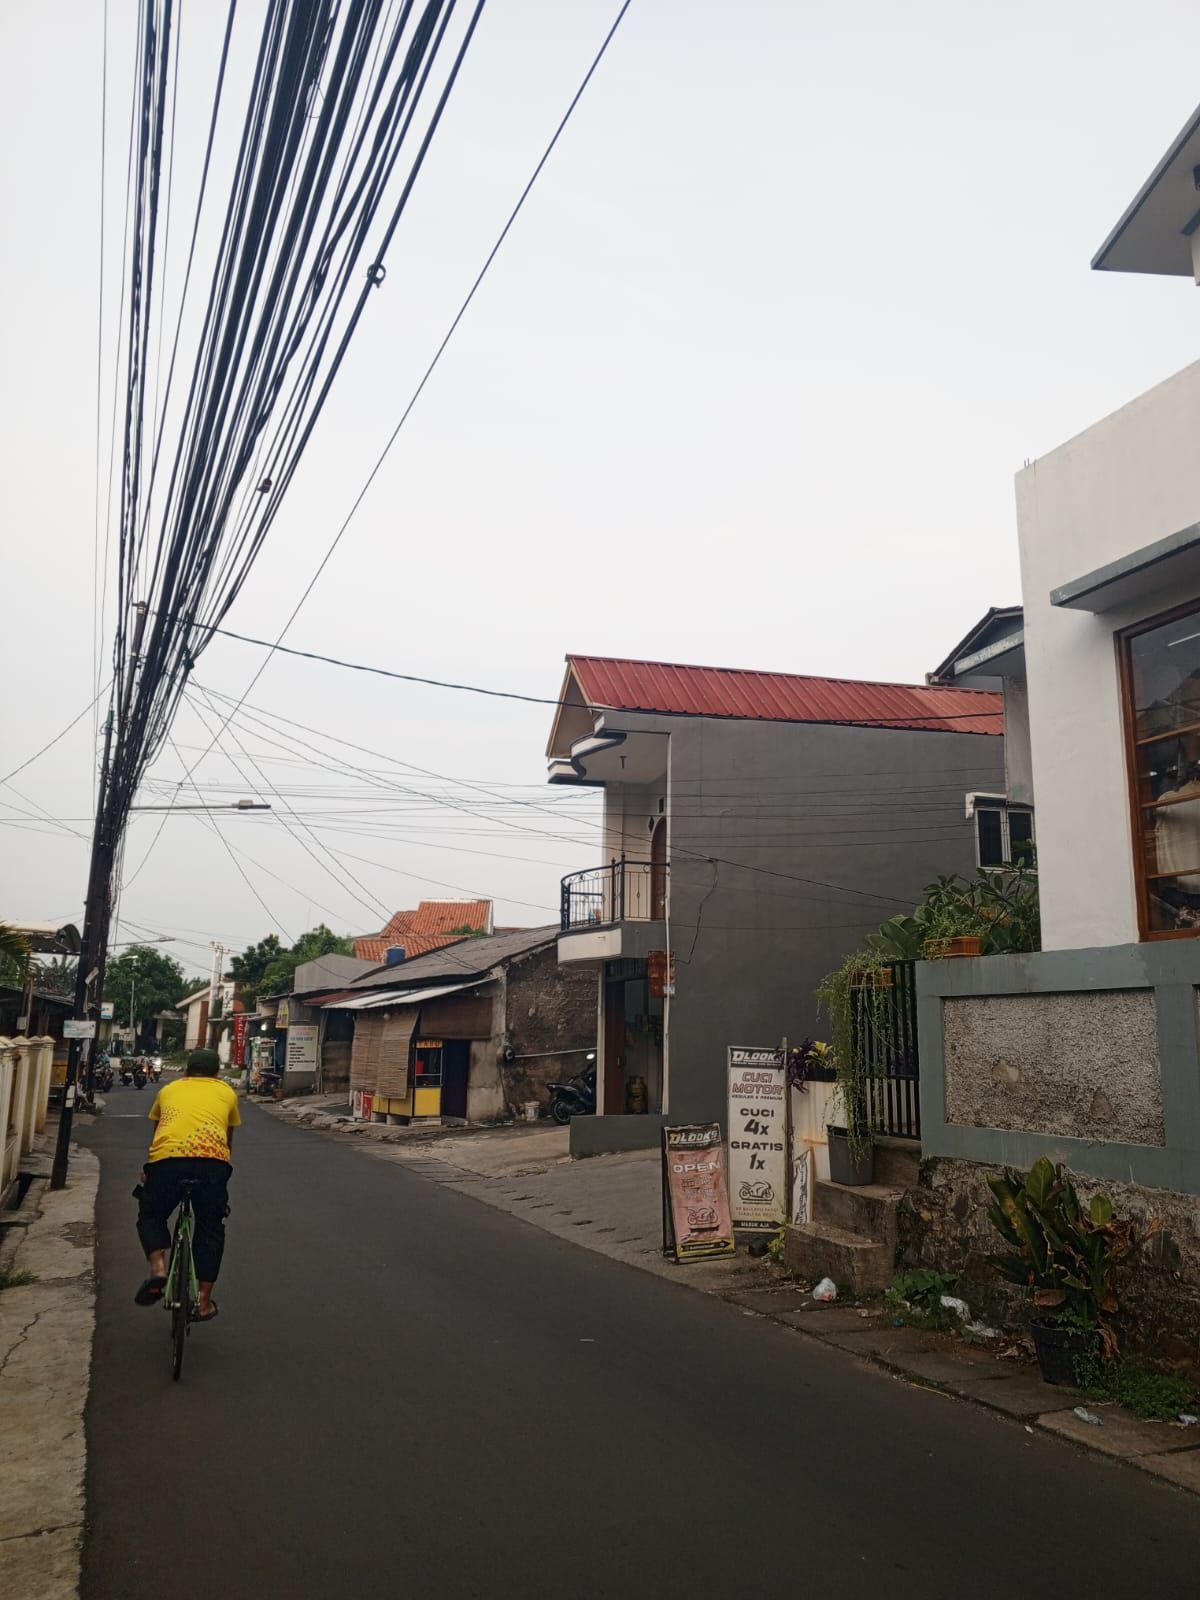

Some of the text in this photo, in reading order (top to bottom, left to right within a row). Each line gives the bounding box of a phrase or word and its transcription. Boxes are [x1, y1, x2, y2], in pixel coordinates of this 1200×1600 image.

[732, 1051, 780, 1061] DLOOK
[742, 1072, 773, 1083] CUCI
[732, 1083, 783, 1095] MOTOR
[740, 1108, 774, 1117] CUCI
[669, 1131, 717, 1144] DLOOKS
[731, 1141, 783, 1151] GRATIS
[673, 1162, 720, 1173] OPEN
